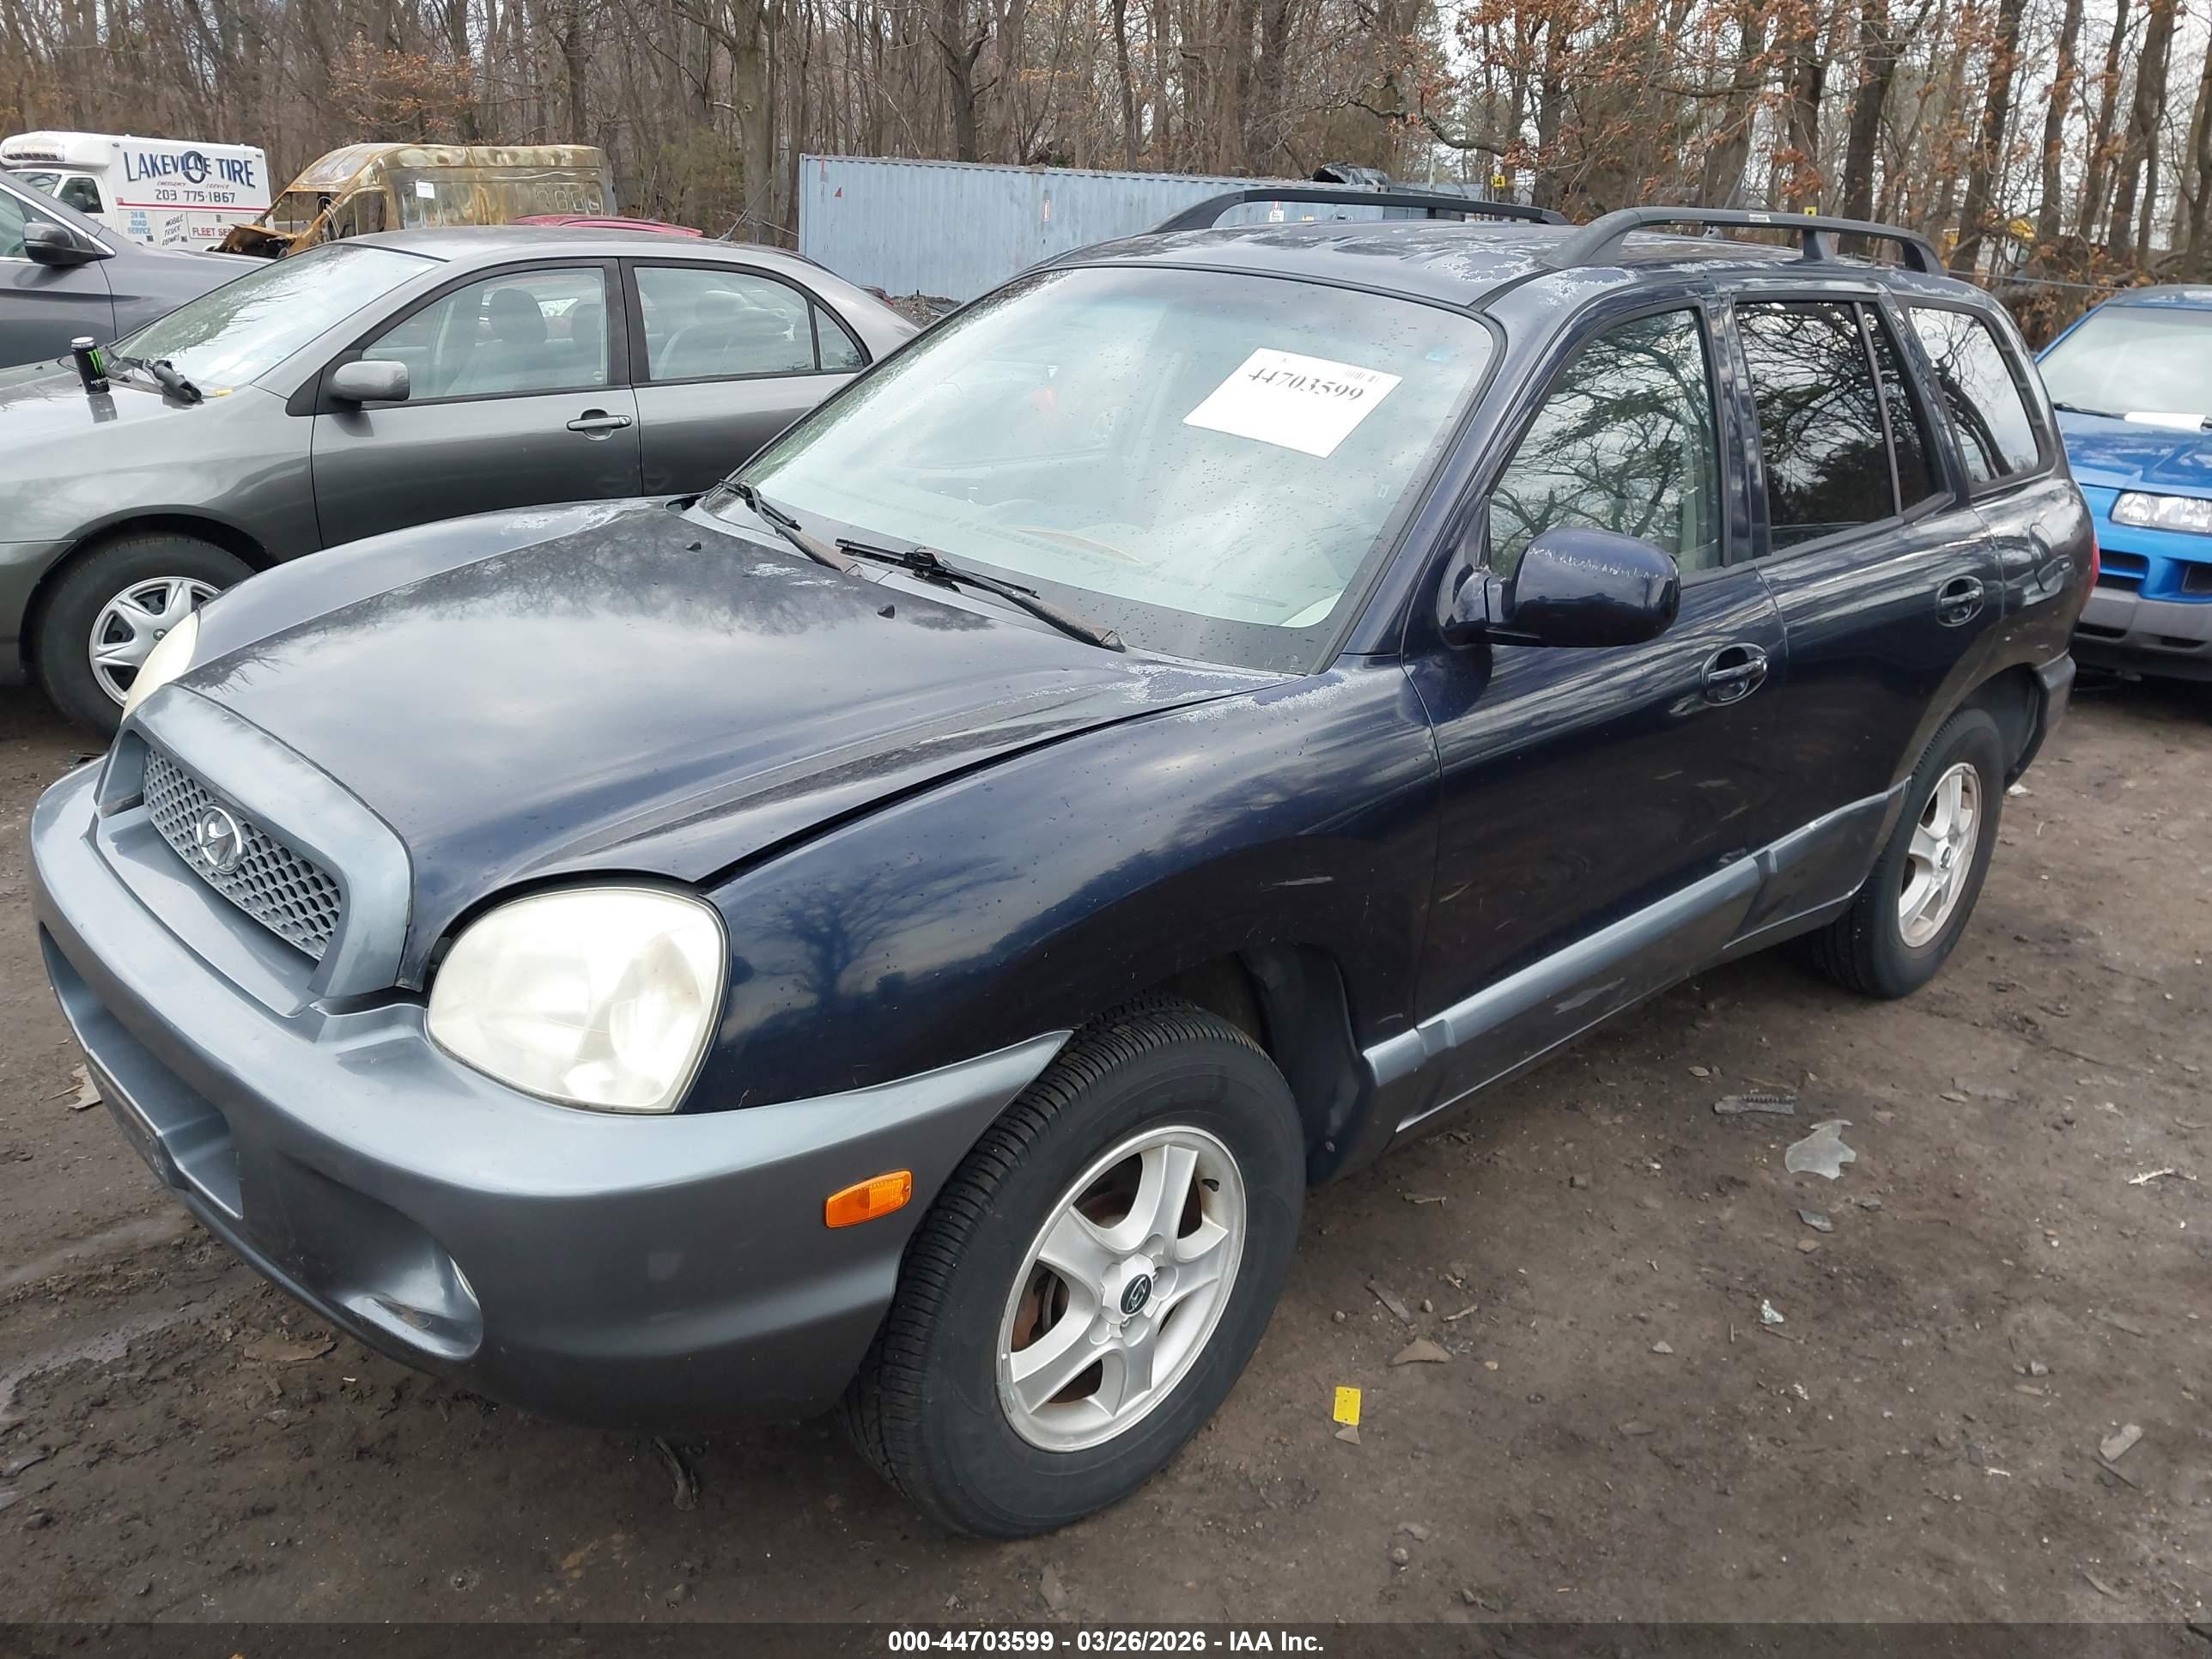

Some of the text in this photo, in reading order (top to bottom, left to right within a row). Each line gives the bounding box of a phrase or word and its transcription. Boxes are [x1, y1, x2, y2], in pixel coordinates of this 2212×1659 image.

[124, 152, 256, 189] LAKEVILLE TIRE
[155, 189, 177, 201] 203
[165, 214, 183, 227] MOBILE
[164, 224, 180, 236] TRUCK
[192, 227, 215, 236] FLEET
[1248, 368, 1364, 401] 44703599
